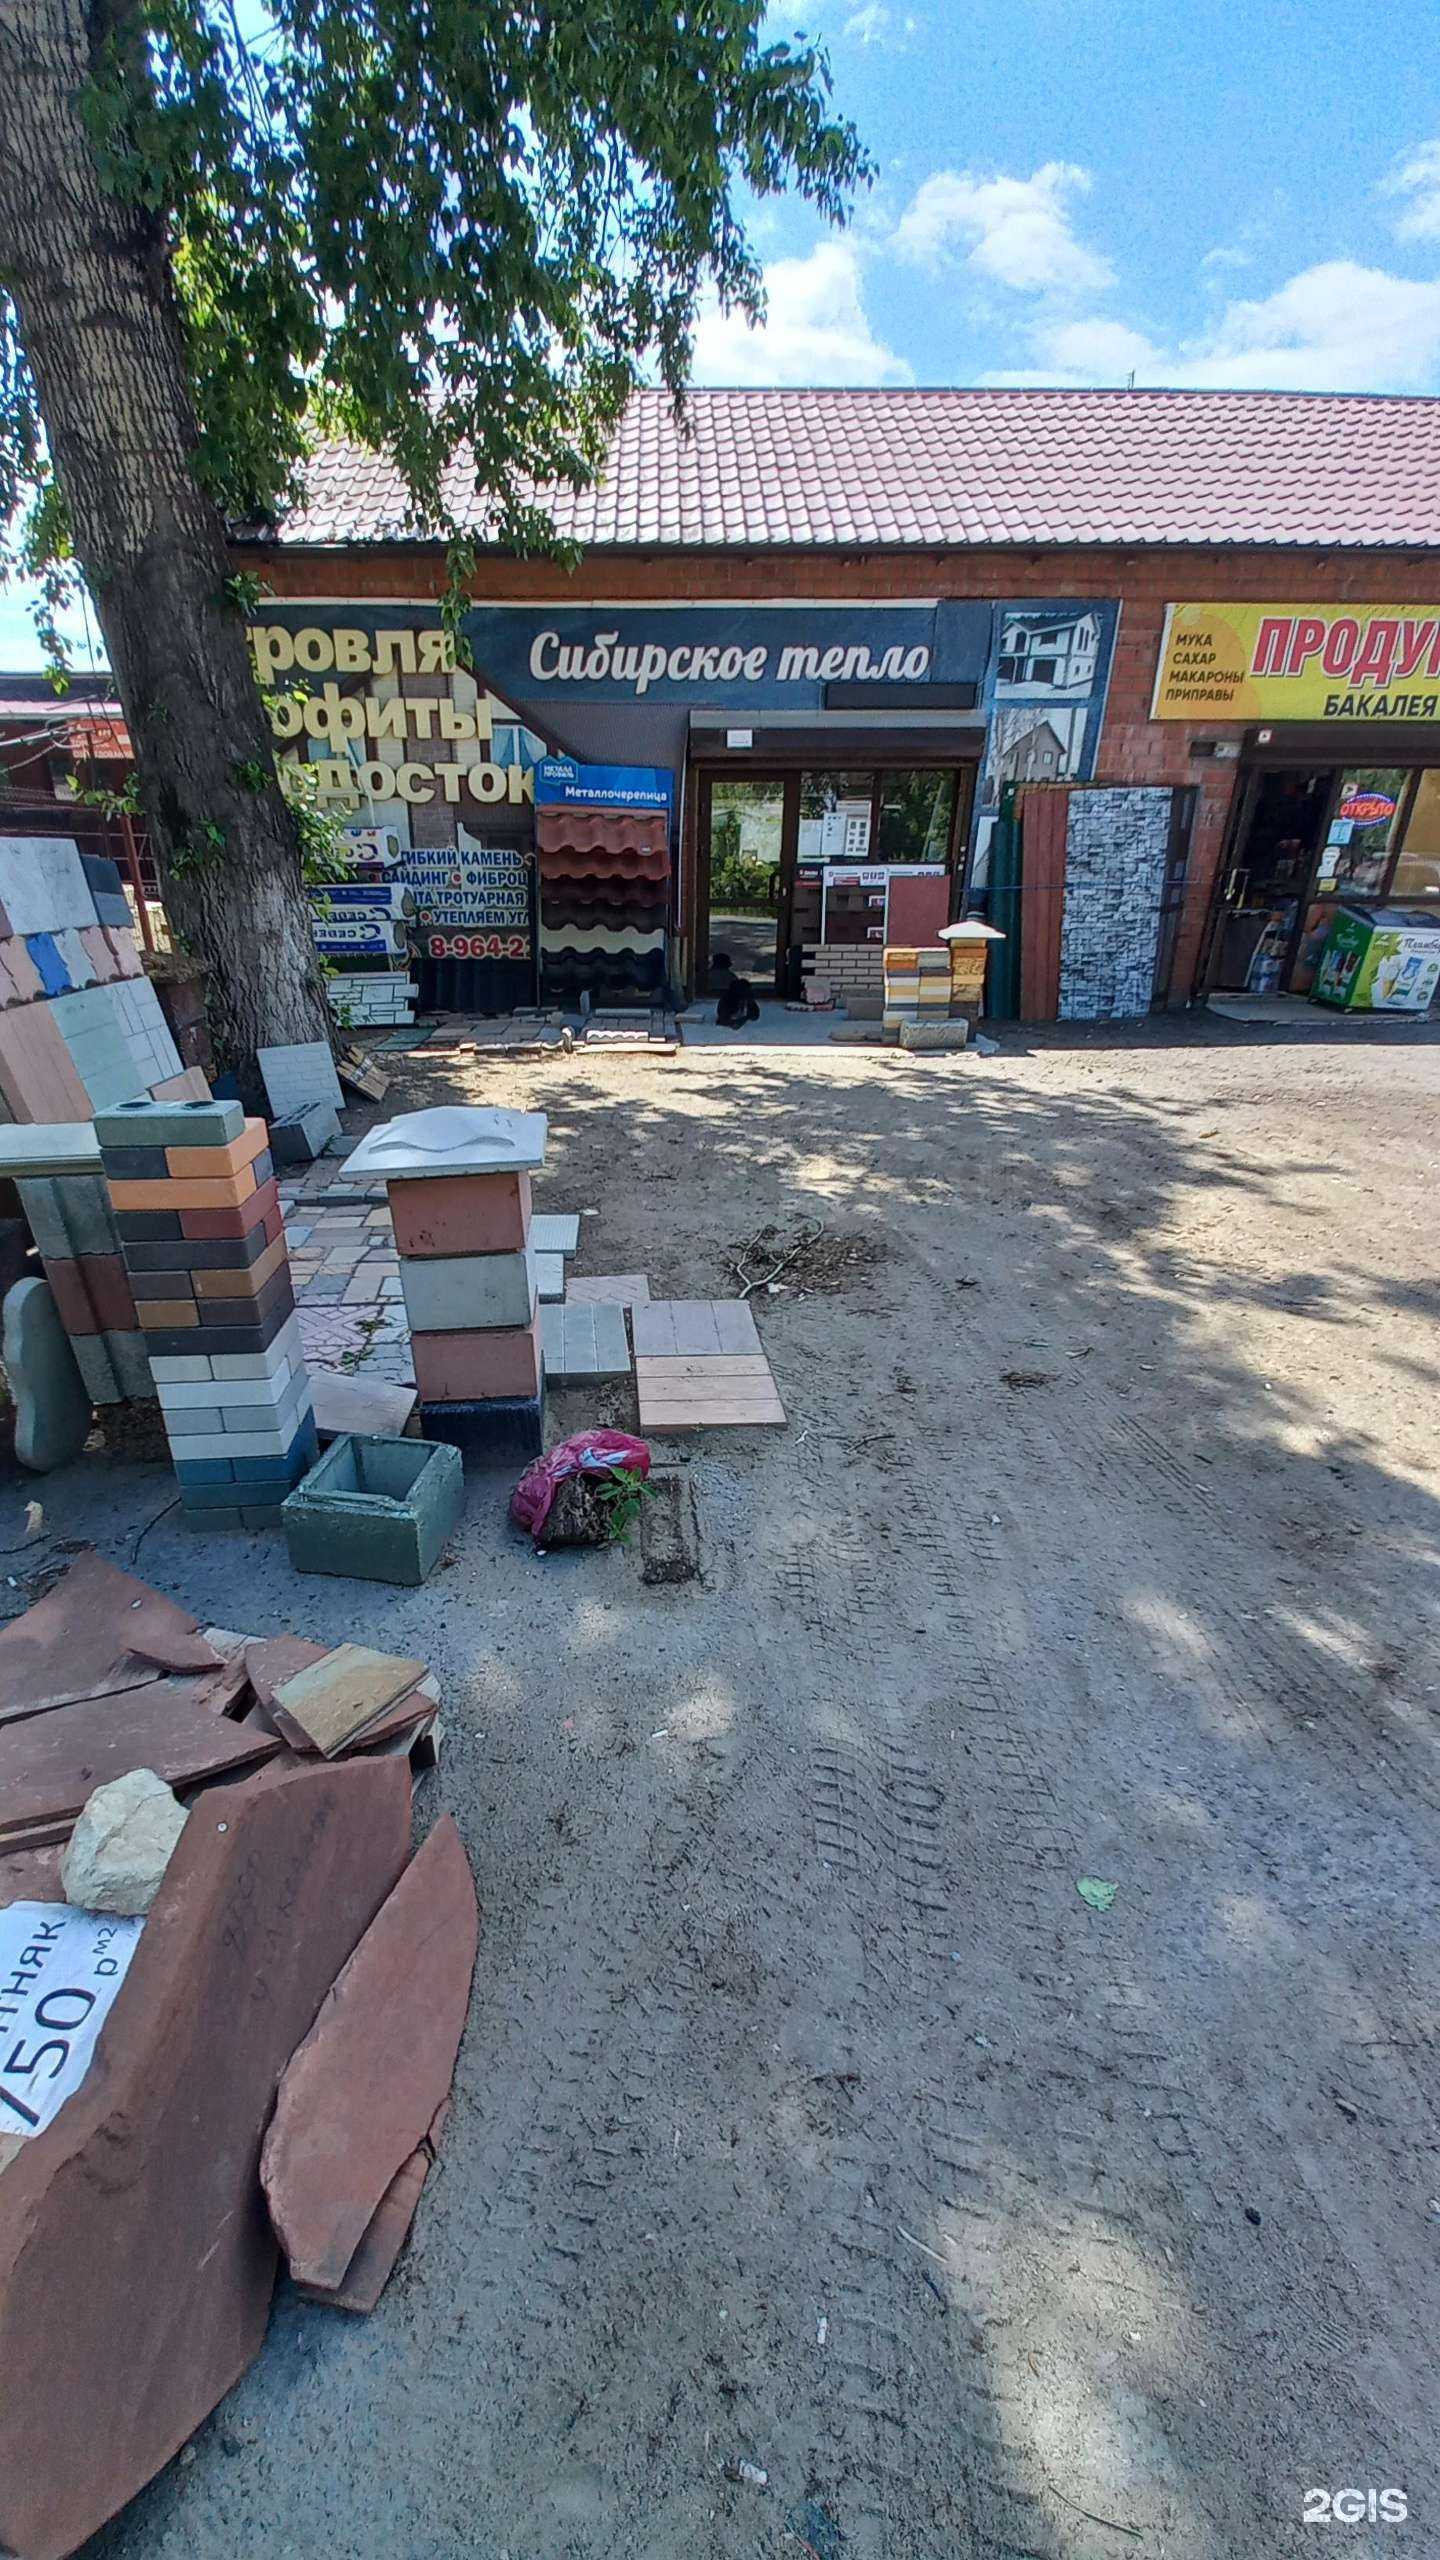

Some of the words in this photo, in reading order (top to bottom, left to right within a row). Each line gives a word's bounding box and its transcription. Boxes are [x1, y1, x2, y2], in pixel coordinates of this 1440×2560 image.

[1176, 634, 1213, 647] МУКА
[246, 626, 456, 684] ровля
[1173, 652, 1217, 665] САХАР
[529, 631, 767, 695] Сибирское
[776, 645, 930, 681] тепло
[1169, 670, 1245, 683] МАКАРОНЫ
[1166, 688, 1235, 701] ПРИПРАВЫ
[1323, 694, 1438, 717] БАКАЛЕЯ
[565, 785, 667, 802] Металлочерепица
[401, 848, 457, 865] ГИБКИЙ
[460, 850, 523, 865] КАМЕНЬ
[437, 891, 526, 906] ТРОТУАРНАЯ
[433, 910, 505, 924] УТЕПЛЯЕМ
